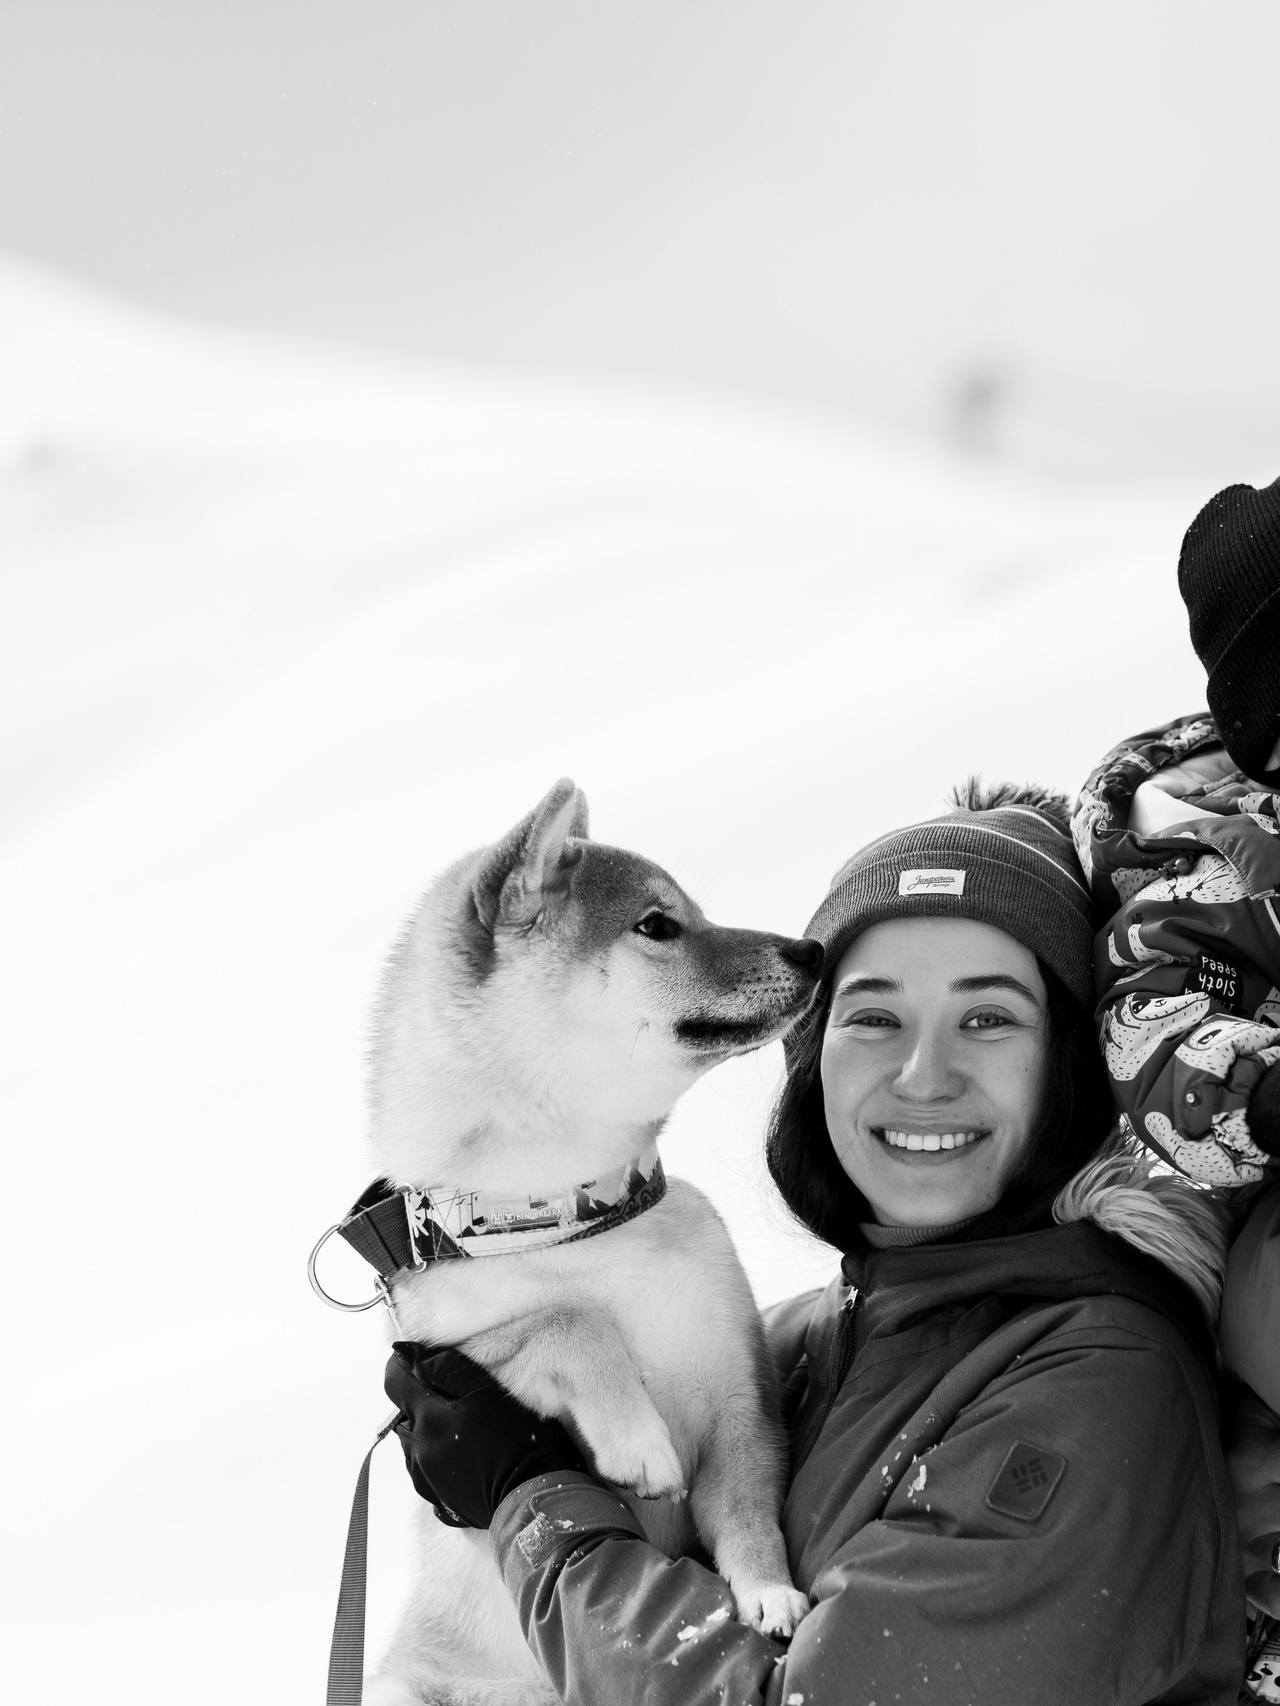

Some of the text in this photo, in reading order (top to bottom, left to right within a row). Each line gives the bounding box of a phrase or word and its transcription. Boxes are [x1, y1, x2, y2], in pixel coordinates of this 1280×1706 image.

[1201, 956, 1237, 978] speed
[1198, 972, 1236, 997] Sloth
[516, 1209, 564, 1220] BENDER&FRA
